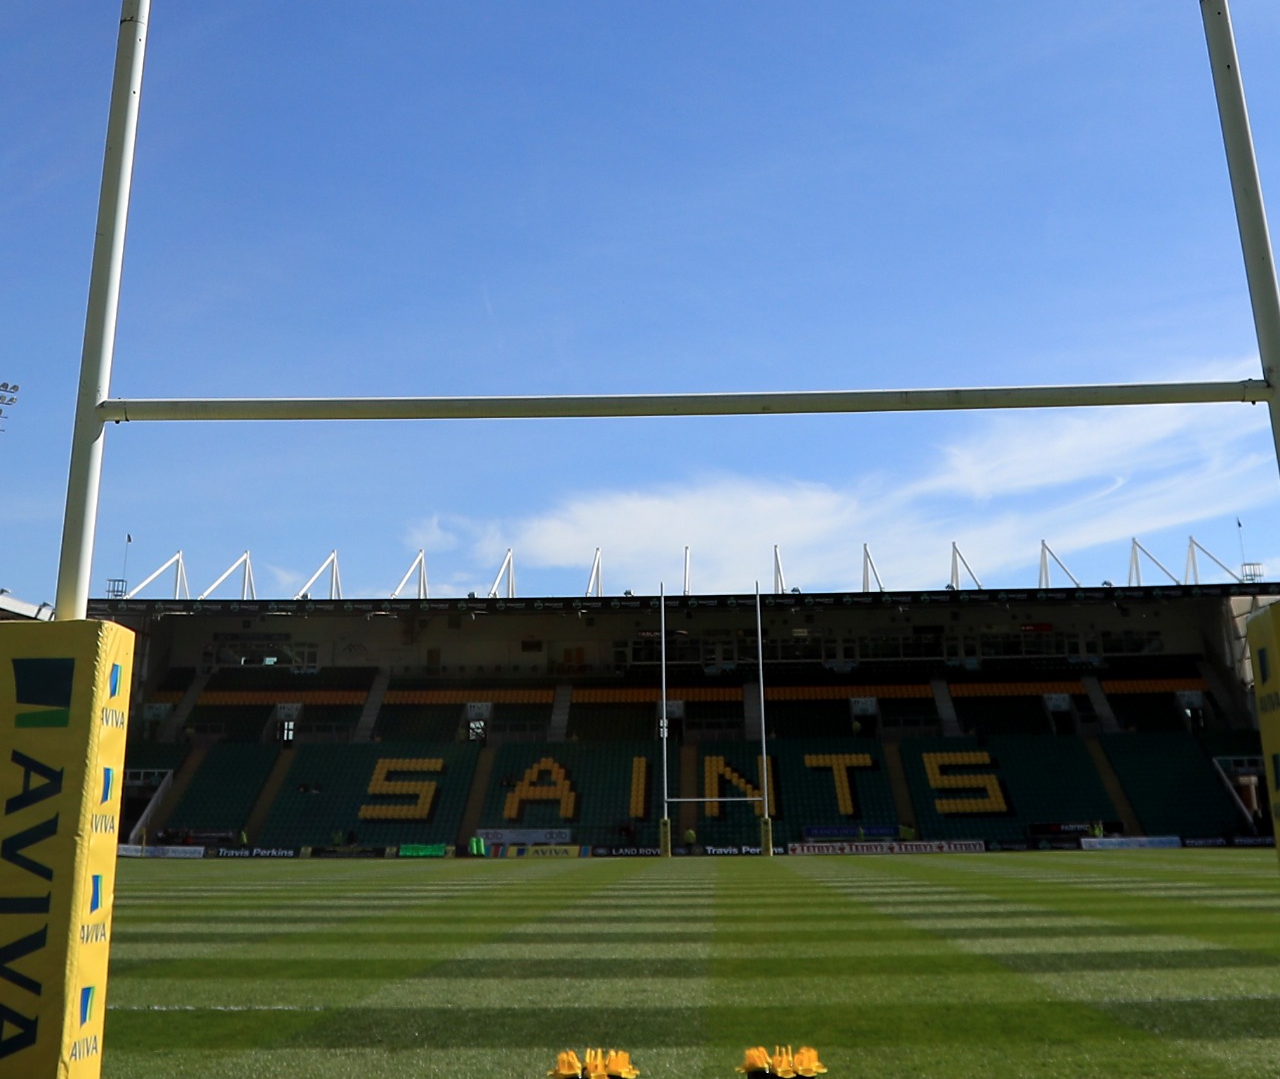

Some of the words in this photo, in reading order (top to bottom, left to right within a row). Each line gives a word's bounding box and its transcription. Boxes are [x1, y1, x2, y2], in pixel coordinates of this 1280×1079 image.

[219, 849, 249, 857] Travis
[253, 849, 294, 857] Perkins
[532, 848, 569, 856] AVIVA
[612, 848, 636, 856] LAND
[705, 846, 738, 854] Travis
[79, 924, 106, 943] AVIVA
[69, 1043, 98, 1061] AVIVA
